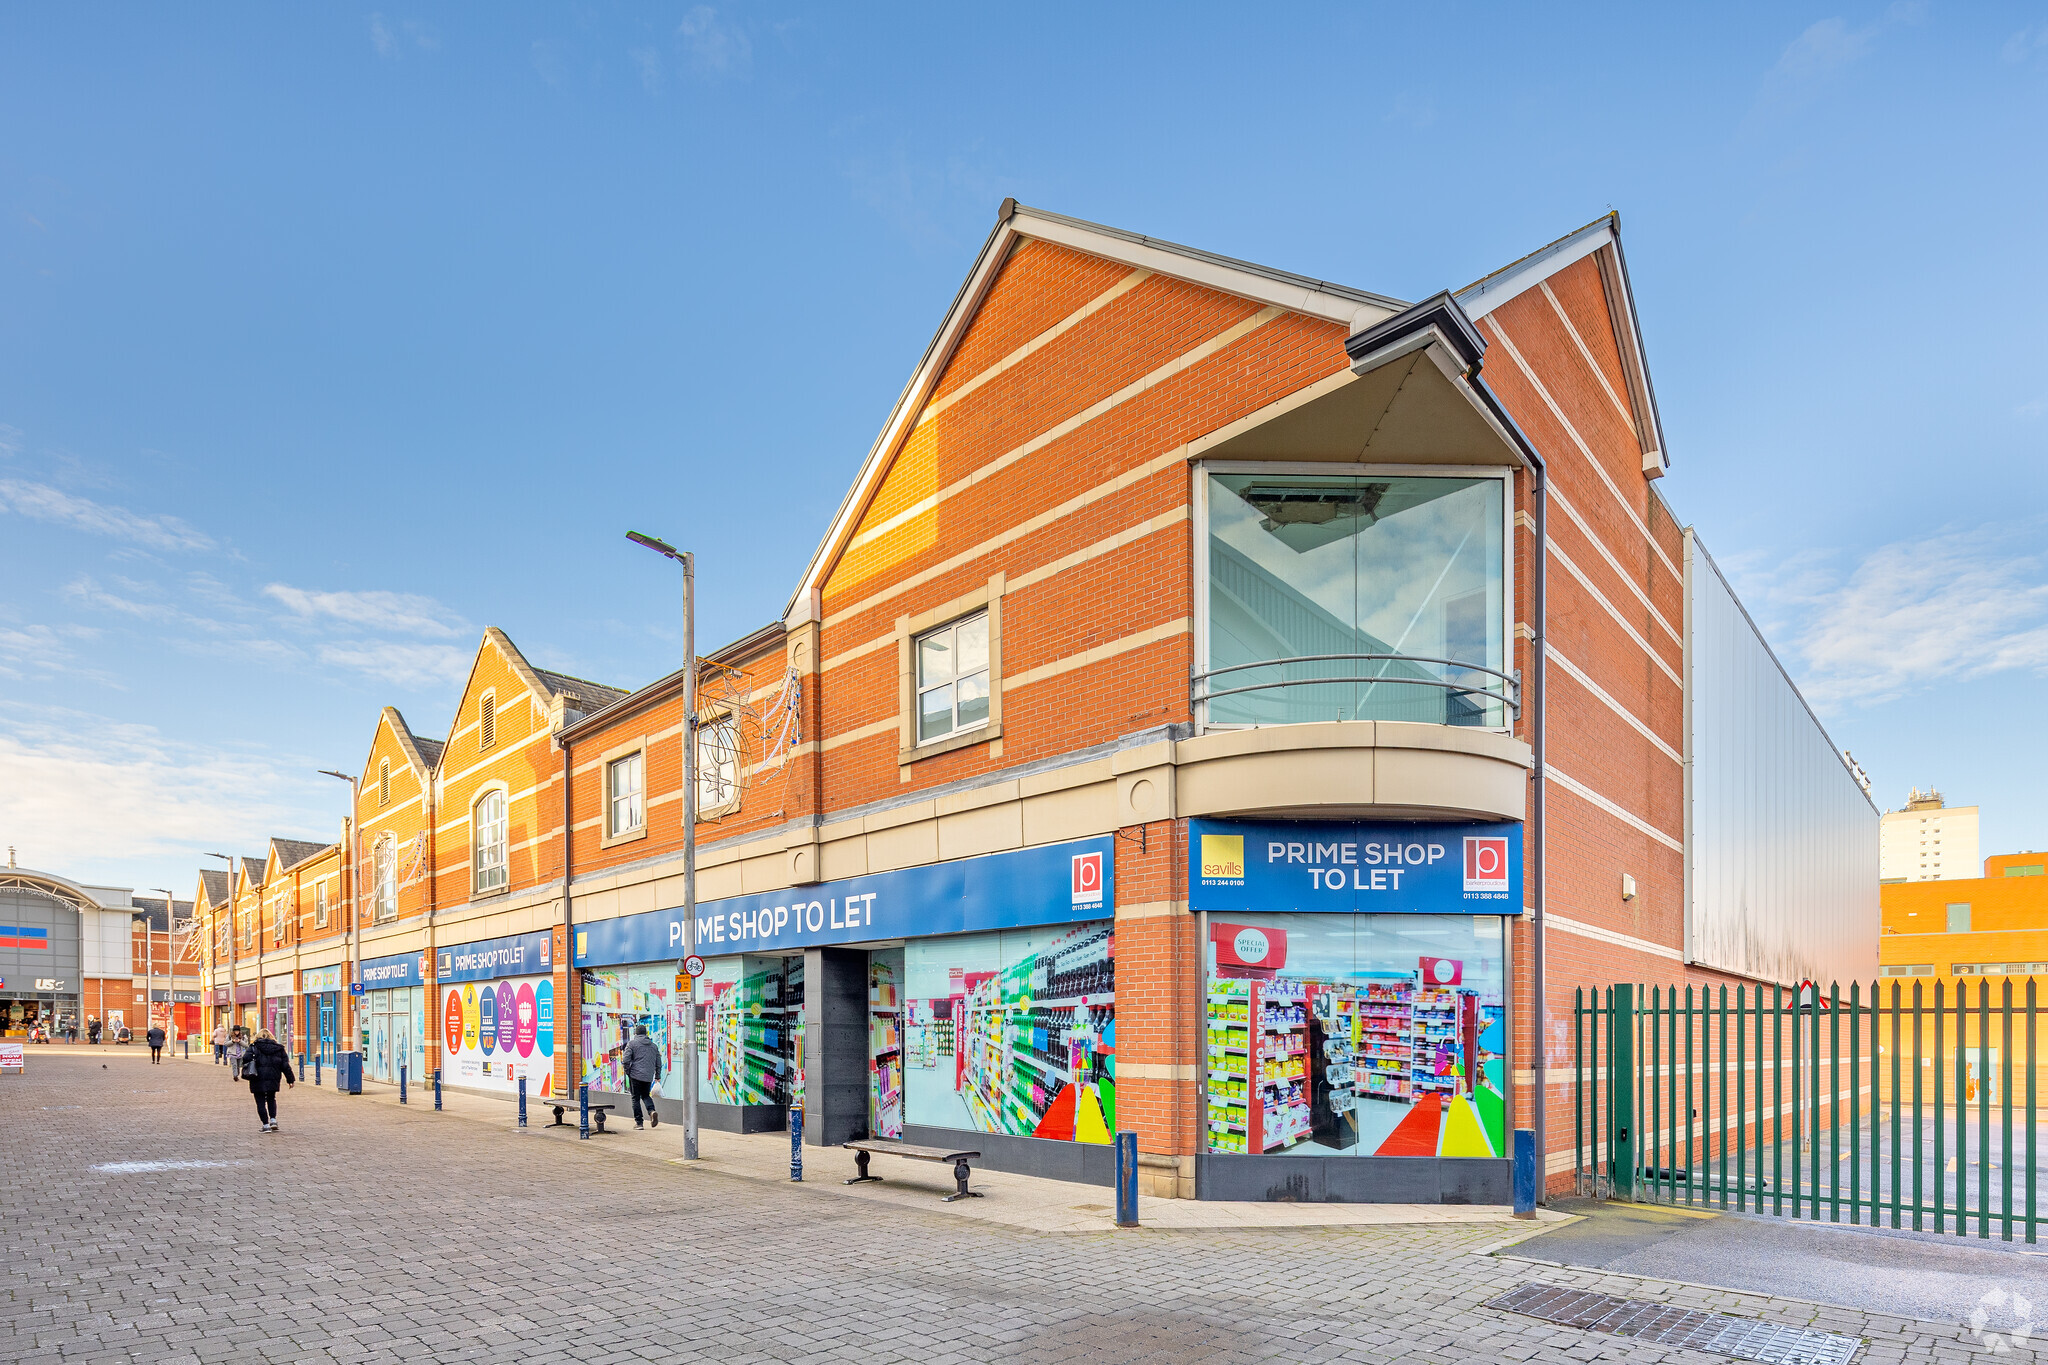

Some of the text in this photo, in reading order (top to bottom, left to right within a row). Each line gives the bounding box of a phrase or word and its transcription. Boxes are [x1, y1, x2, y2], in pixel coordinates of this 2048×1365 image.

[1268, 842, 1446, 865] PRIME SHOP
[1203, 862, 1242, 876] savills
[1217, 879, 1229, 887] 244
[1229, 879, 1245, 887] 0100
[1307, 868, 1405, 890] TO LET
[1463, 892, 1479, 900] 0113
[669, 892, 877, 948] PIME SHOP TO LET
[1237, 938, 1266, 947] SPECIAL
[1240, 946, 1263, 954] OFFER
[455, 946, 525, 972] PRIME SHOP TO LET
[363, 963, 408, 982] PRIME SHOP TO LET
[1255, 985, 1266, 1100] SPECIAL OFFERS
